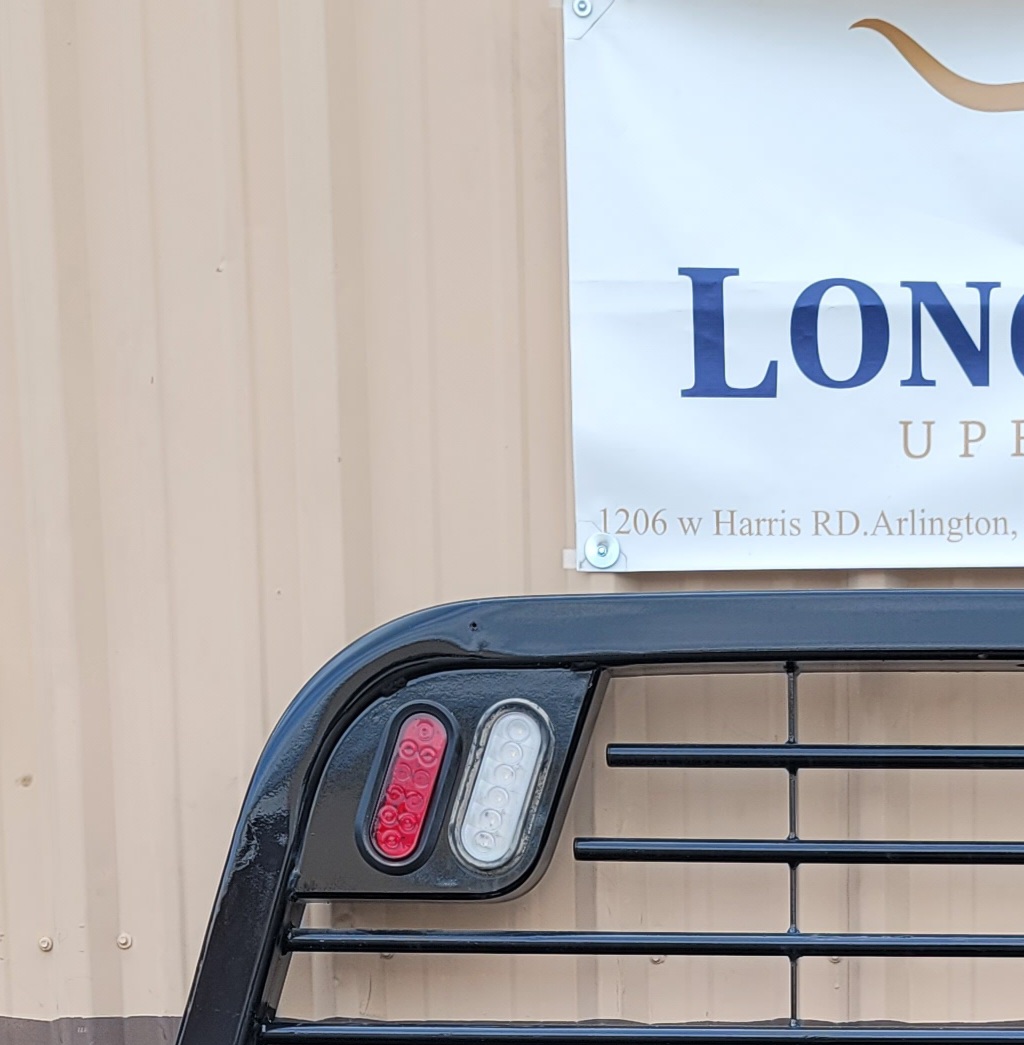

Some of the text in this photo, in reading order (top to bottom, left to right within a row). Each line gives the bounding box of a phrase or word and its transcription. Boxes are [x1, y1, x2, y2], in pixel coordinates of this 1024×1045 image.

[599, 507, 668, 536] 1206
[676, 516, 703, 536] w
[712, 509, 801, 536] Harris
